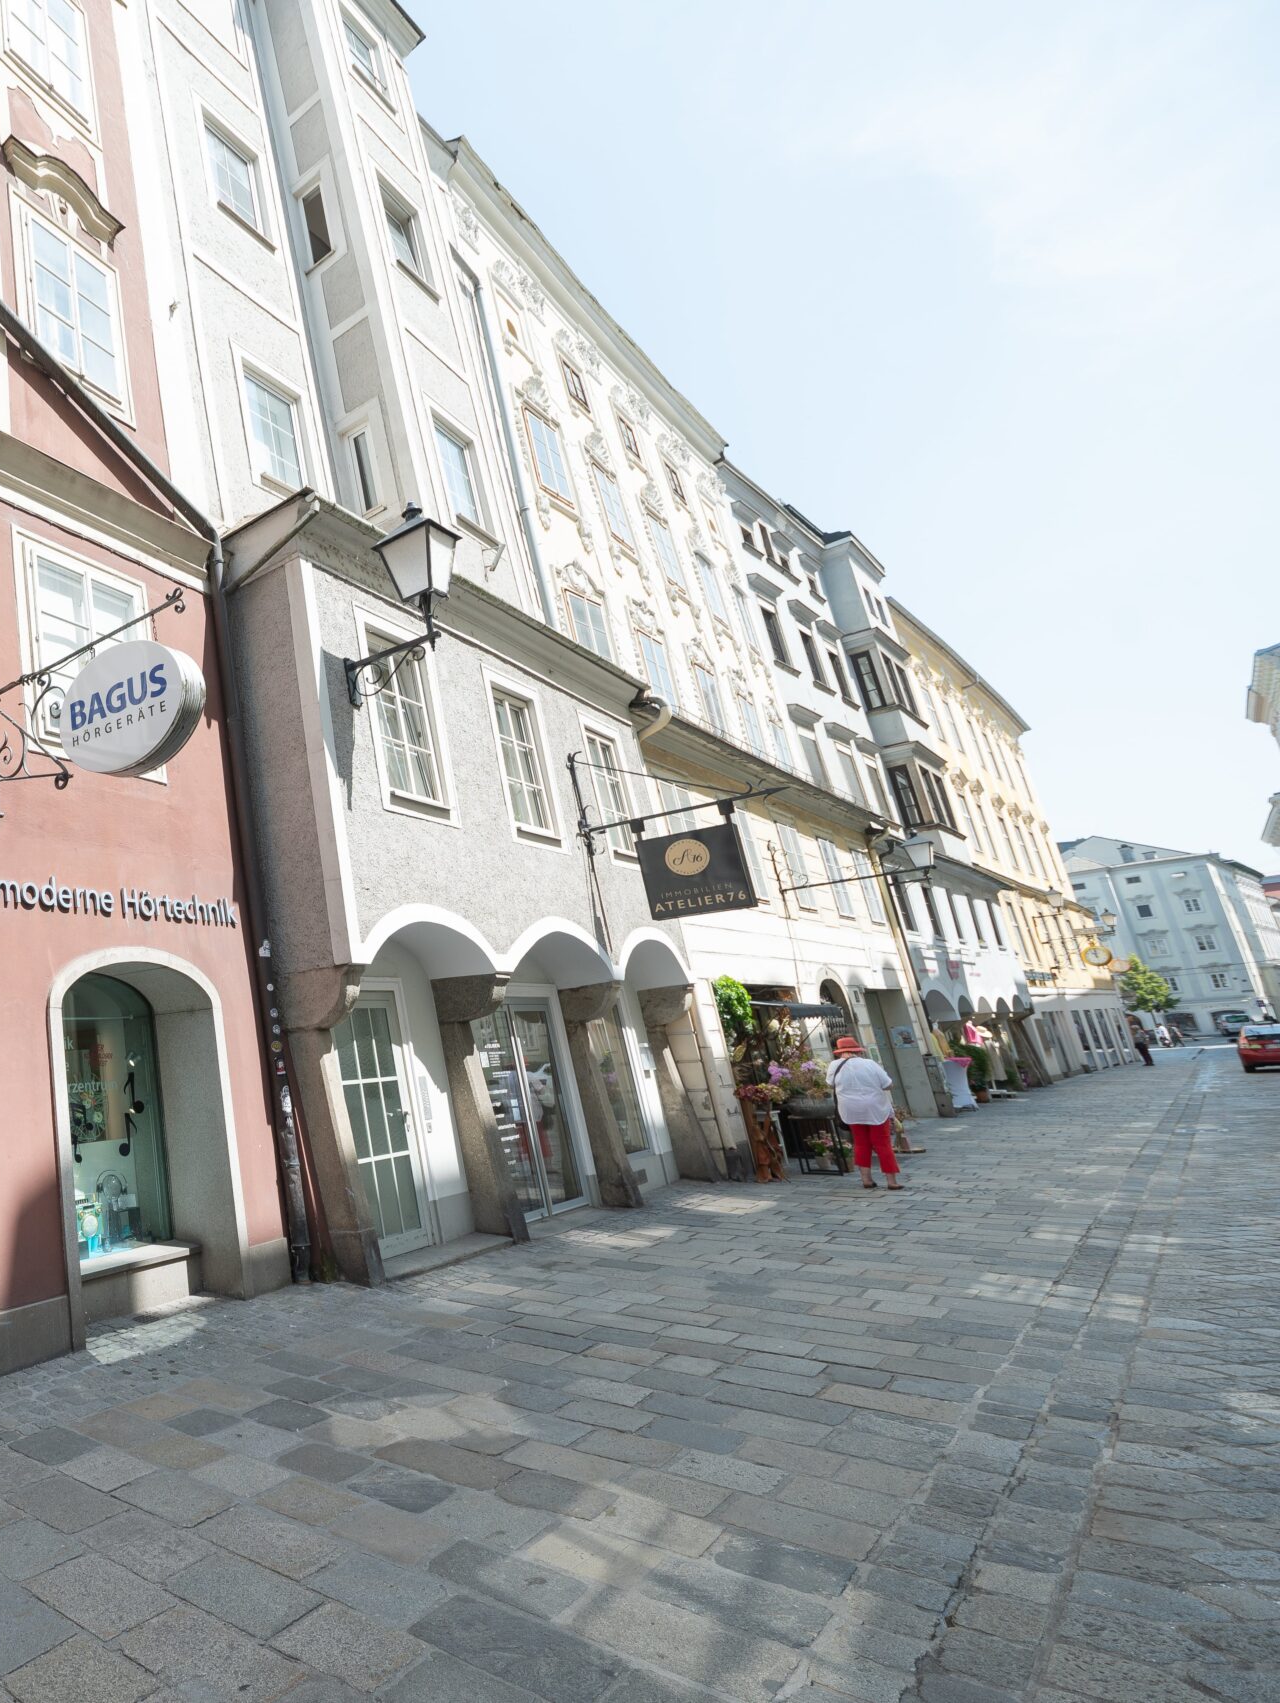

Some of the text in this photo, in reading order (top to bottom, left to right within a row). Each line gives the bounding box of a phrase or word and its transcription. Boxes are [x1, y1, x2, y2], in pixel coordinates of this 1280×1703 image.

[70, 663, 167, 731] BAGUS
[72, 700, 167, 747] HÖRGERÄTE
[120, 887, 238, 928] Hörtechnik
[655, 890, 747, 913] ATELIER76
[660, 881, 734, 899] IMMOBILIEN
